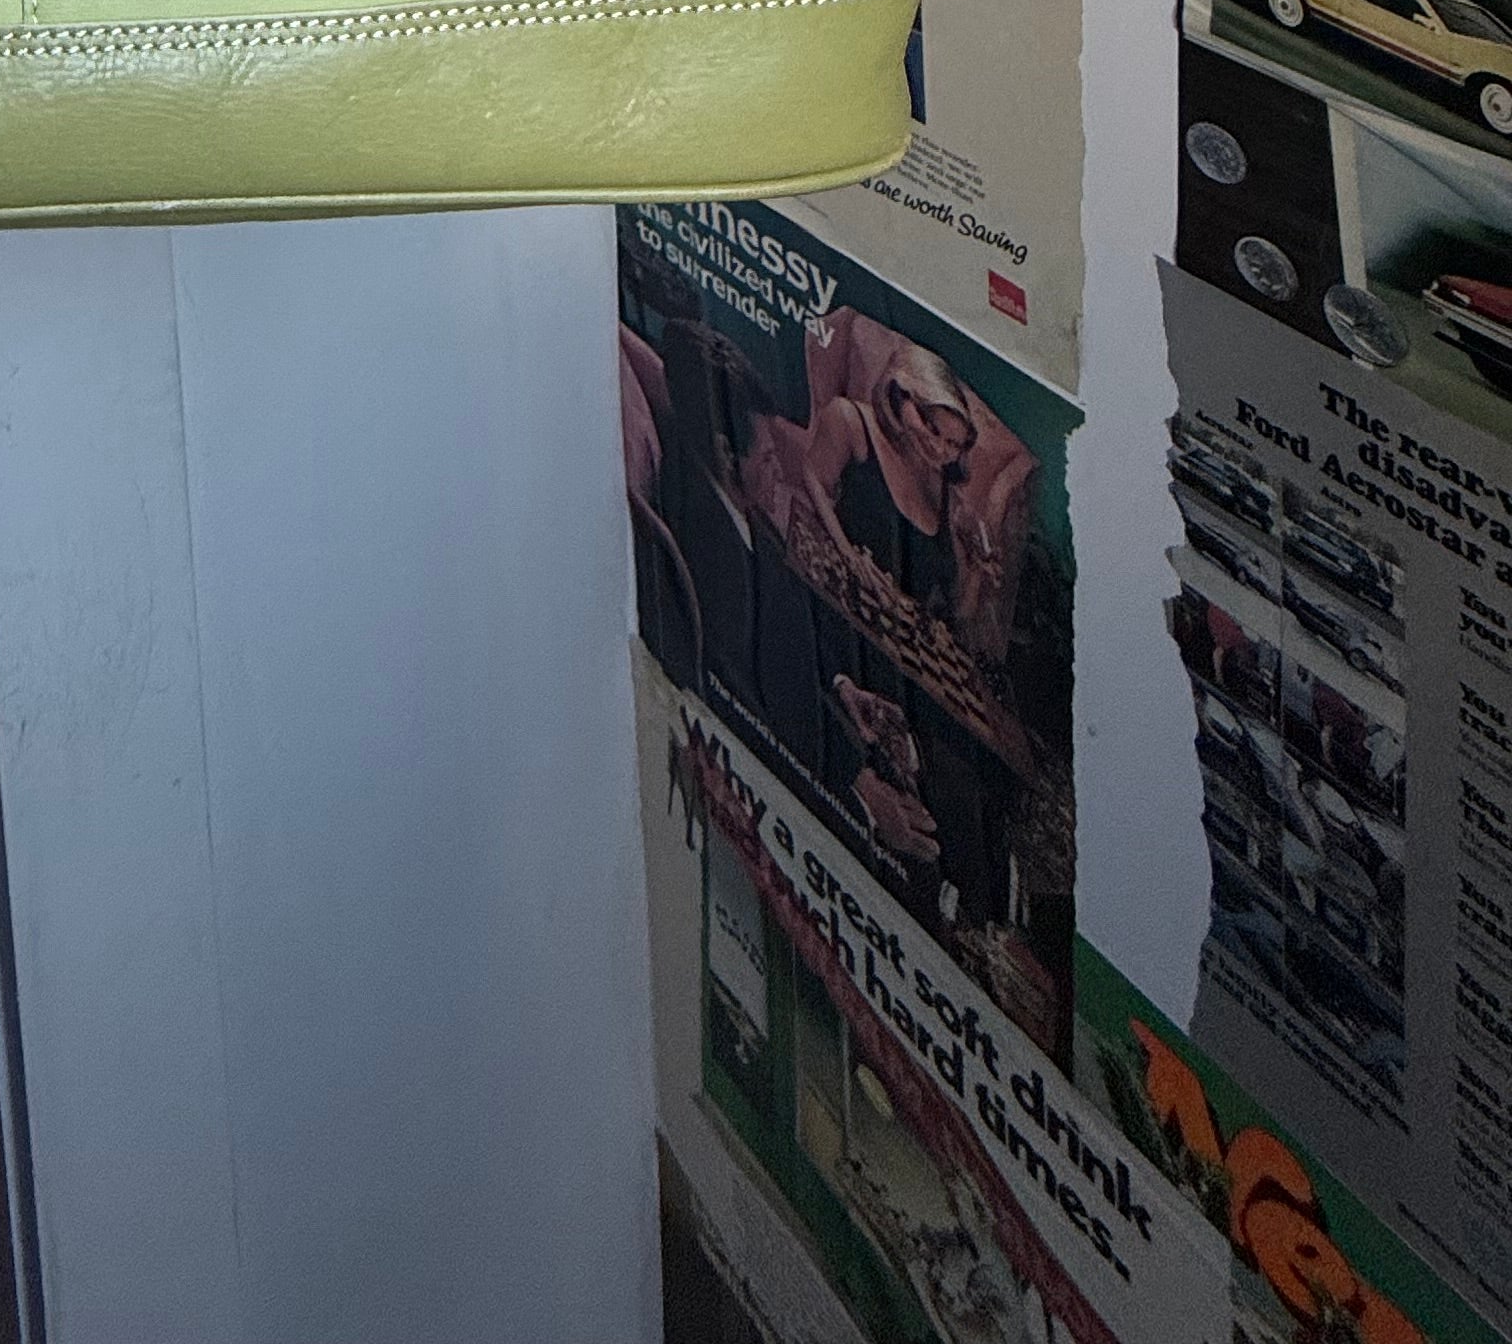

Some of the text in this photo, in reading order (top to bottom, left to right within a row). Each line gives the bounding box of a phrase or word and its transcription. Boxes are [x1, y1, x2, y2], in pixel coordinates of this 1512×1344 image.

[636, 219, 782, 339] to surrender
[676, 219, 774, 304] civilized
[777, 289, 834, 349] way
[874, 175, 1029, 266] are worth Saving
[1319, 381, 1390, 442] The
[1235, 397, 1311, 463] Ford
[1320, 453, 1487, 568] Aerostar
[803, 853, 906, 979] great
[913, 967, 1000, 1081] soft
[1010, 1071, 1152, 1244] drink
[865, 963, 1132, 1283] hard times.
